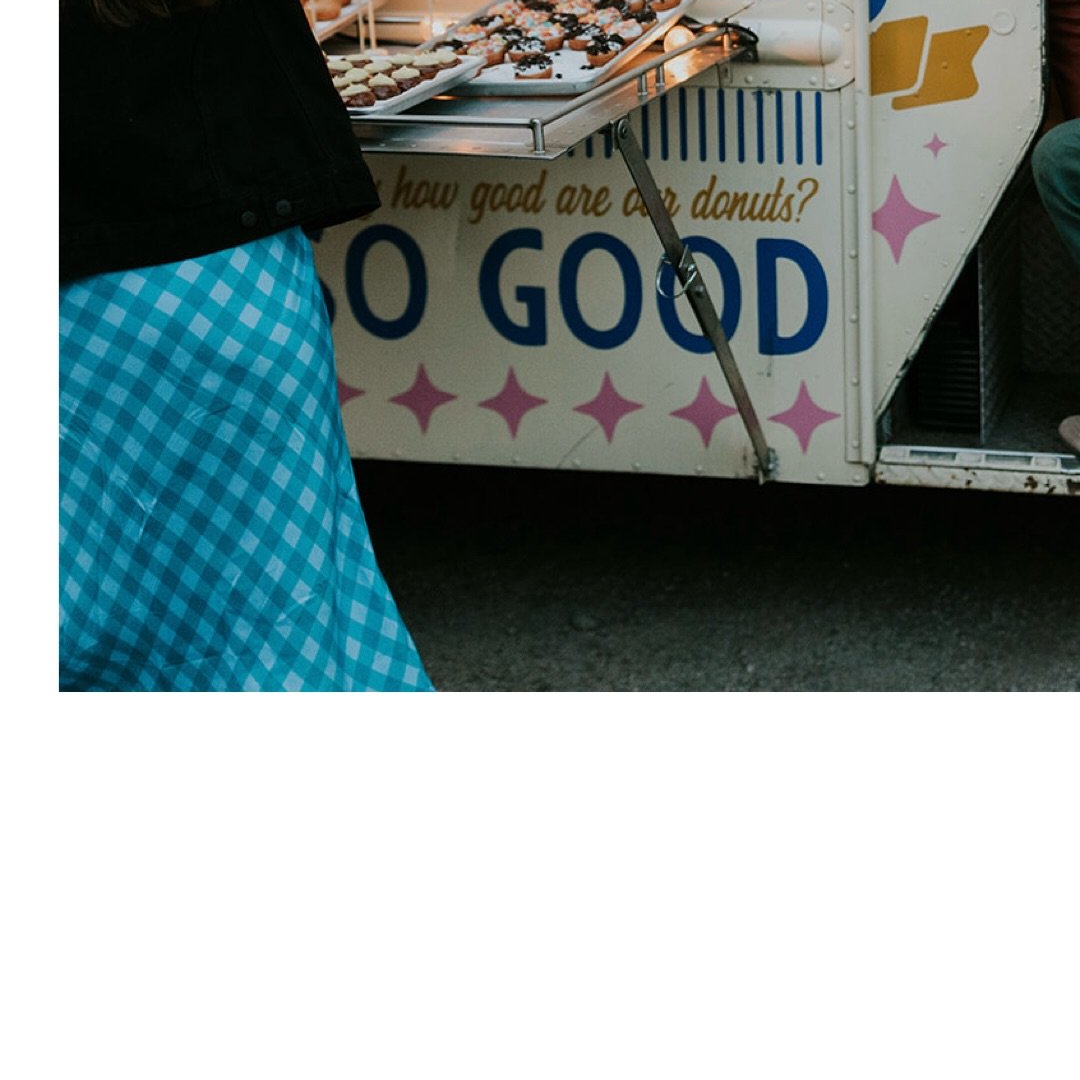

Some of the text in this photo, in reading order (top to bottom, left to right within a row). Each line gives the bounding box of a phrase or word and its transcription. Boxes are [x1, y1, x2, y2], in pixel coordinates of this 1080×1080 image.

[391, 164, 459, 211] how
[468, 168, 547, 224] good
[555, 183, 613, 218] are
[690, 174, 820, 223] donuts?
[319, 223, 829, 356] O GOOD
